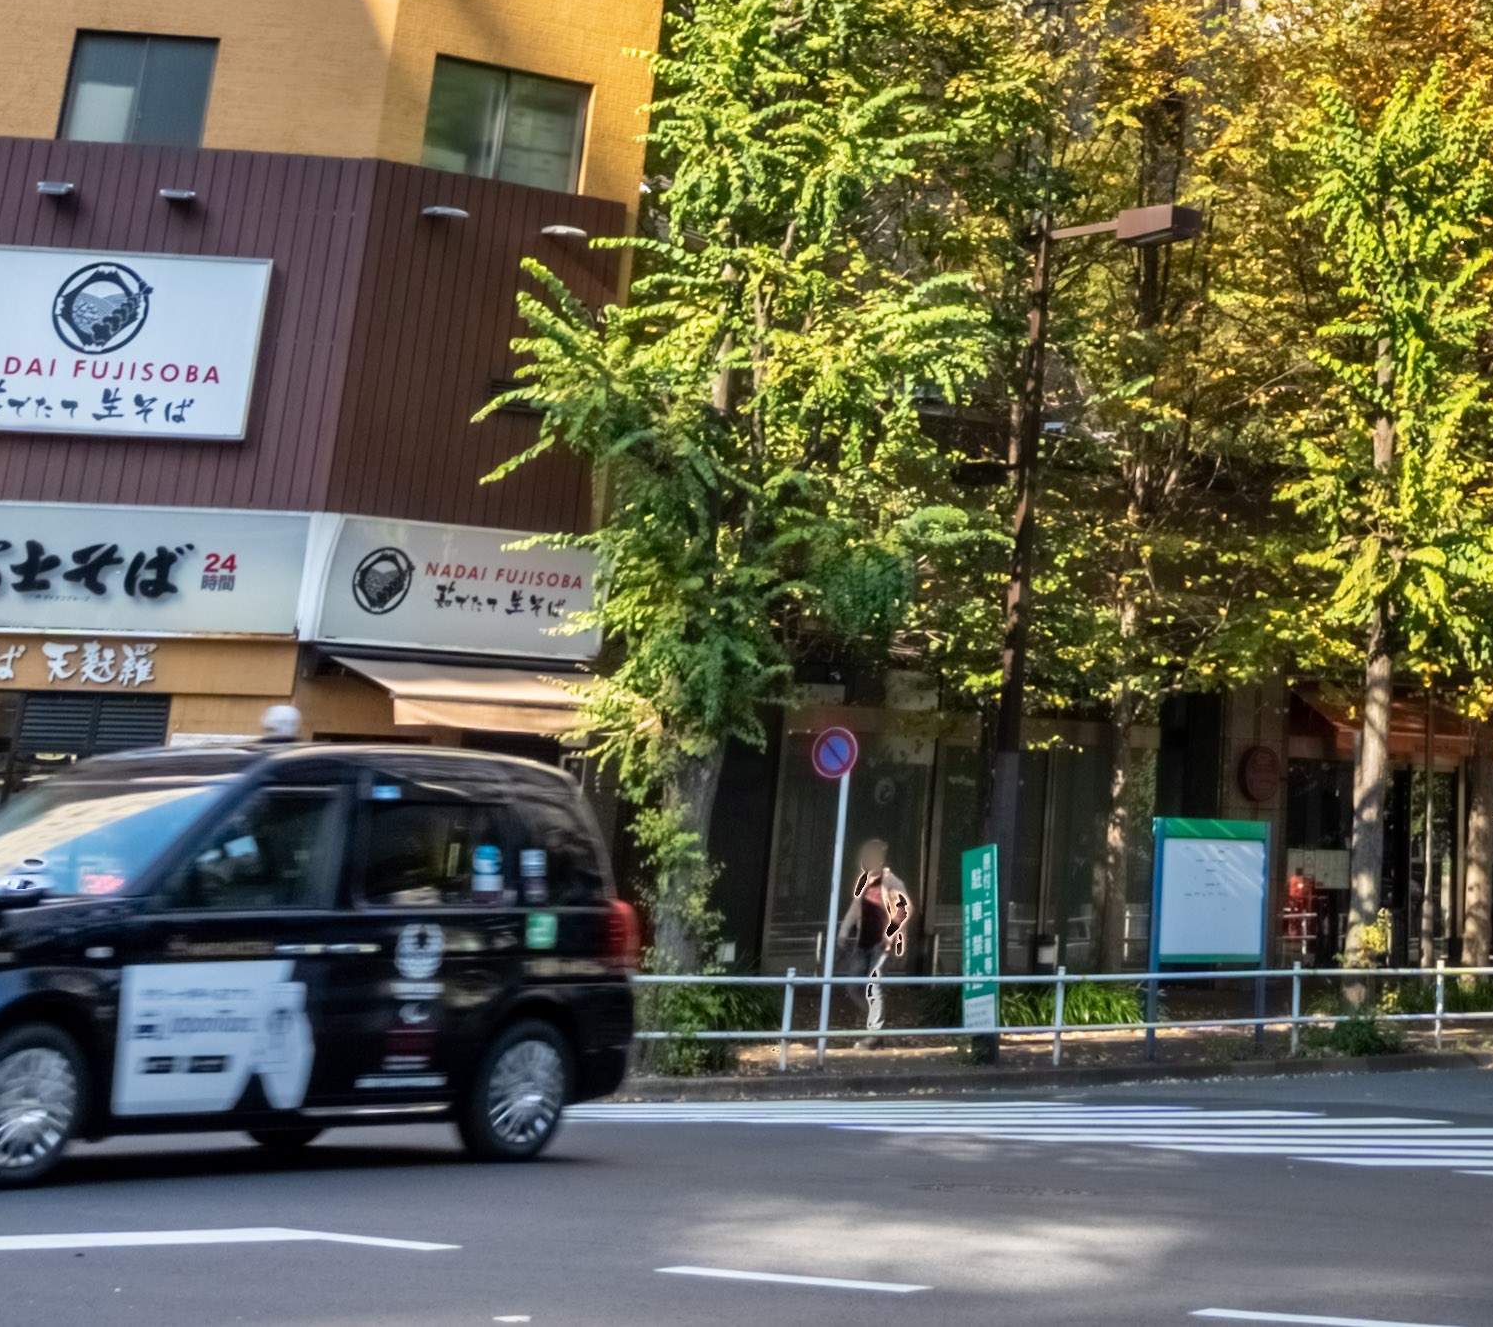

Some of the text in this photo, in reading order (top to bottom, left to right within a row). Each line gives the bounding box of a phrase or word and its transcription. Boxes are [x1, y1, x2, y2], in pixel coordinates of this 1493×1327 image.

[73, 360, 221, 385] FUJISOBA
[92, 387, 195, 424] 生そば
[203, 553, 237, 573] 24
[425, 561, 584, 590] NADAI FUJISOBA
[200, 574, 236, 592] 時間
[971, 868, 985, 991] 駐車禁止
